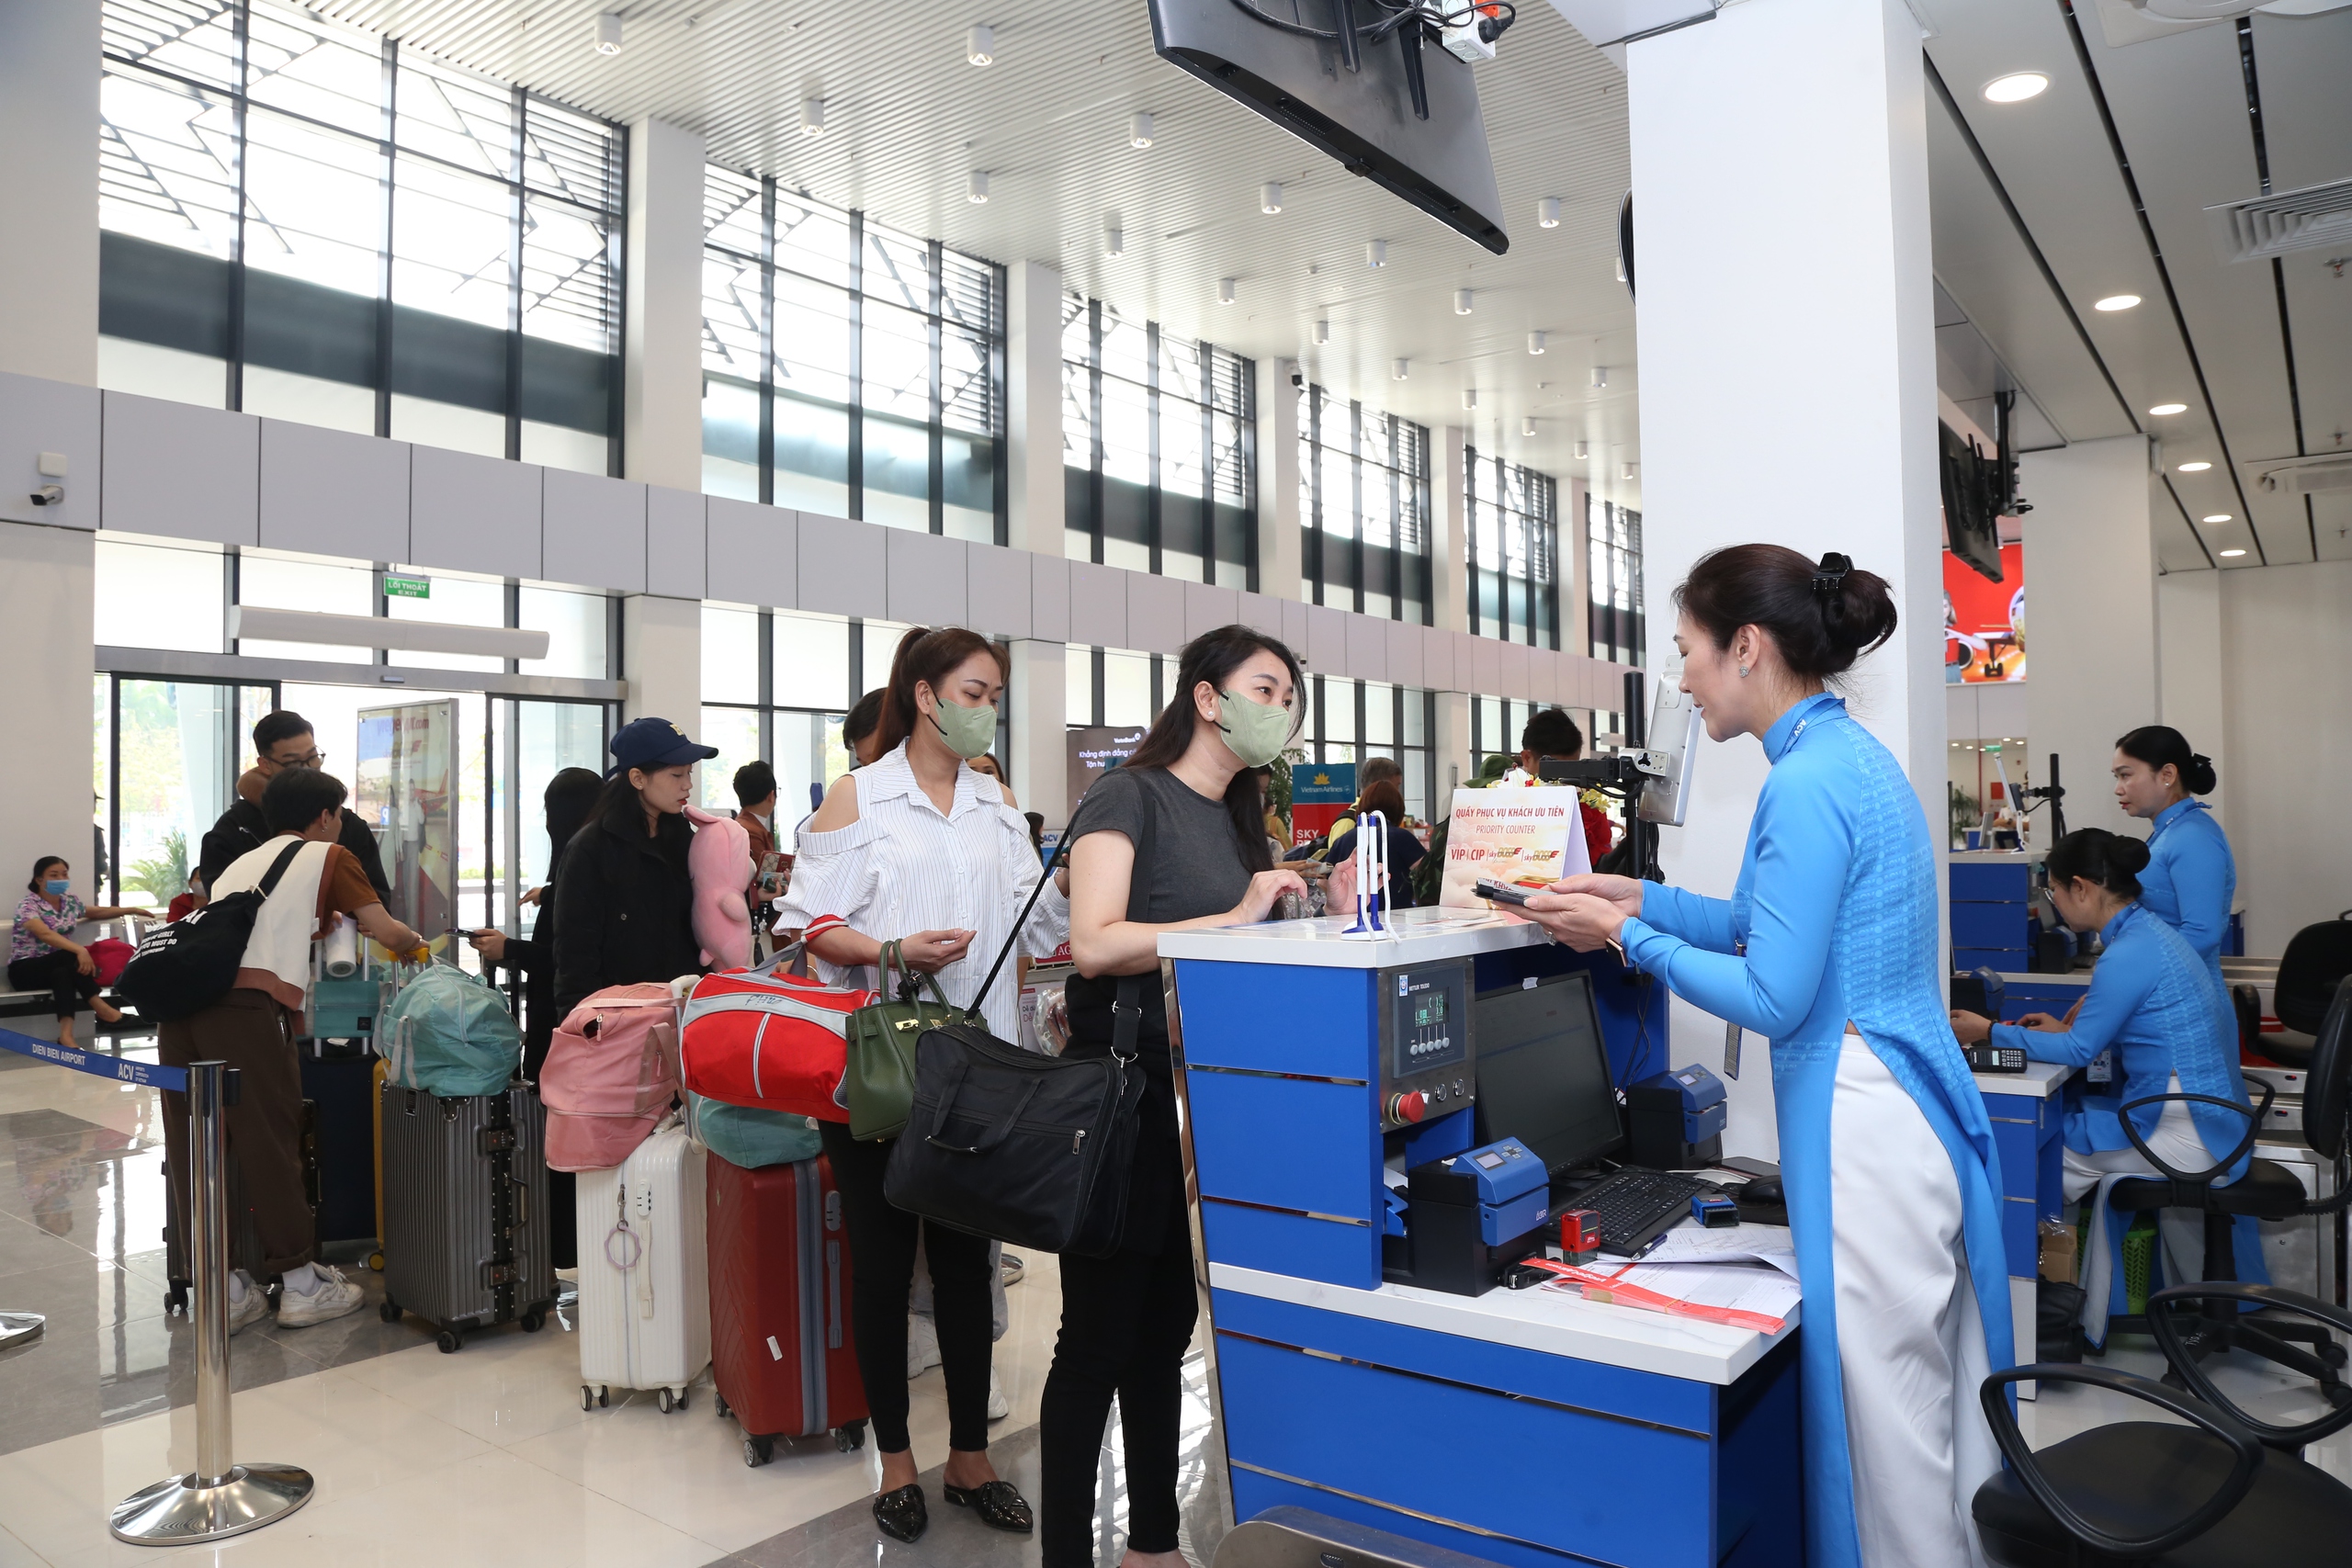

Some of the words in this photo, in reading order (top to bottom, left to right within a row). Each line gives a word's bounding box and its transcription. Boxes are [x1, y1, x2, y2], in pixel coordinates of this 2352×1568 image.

[401, 582, 426, 592] THOÁT
[1793, 718, 1807, 737] ACV
[1476, 808, 1495, 819] PHỤC
[1497, 808, 1507, 819] VỤ
[1508, 806, 1532, 818] KHÁCH
[1547, 806, 1565, 817] TIÊN
[1296, 829, 1318, 839] SKY
[1476, 825, 1504, 834] PRIORITY
[1506, 825, 1536, 834] COUNTER
[1044, 834, 1058, 842] ACV
[1451, 850, 1465, 861] VIP
[1471, 849, 1485, 861] CIP
[151, 939, 167, 948] MUST
[32, 1043, 46, 1055] DIEN
[47, 1048, 60, 1059] BIEN
[61, 1051, 85, 1066] AIRPORT
[119, 1063, 134, 1080] ACV
